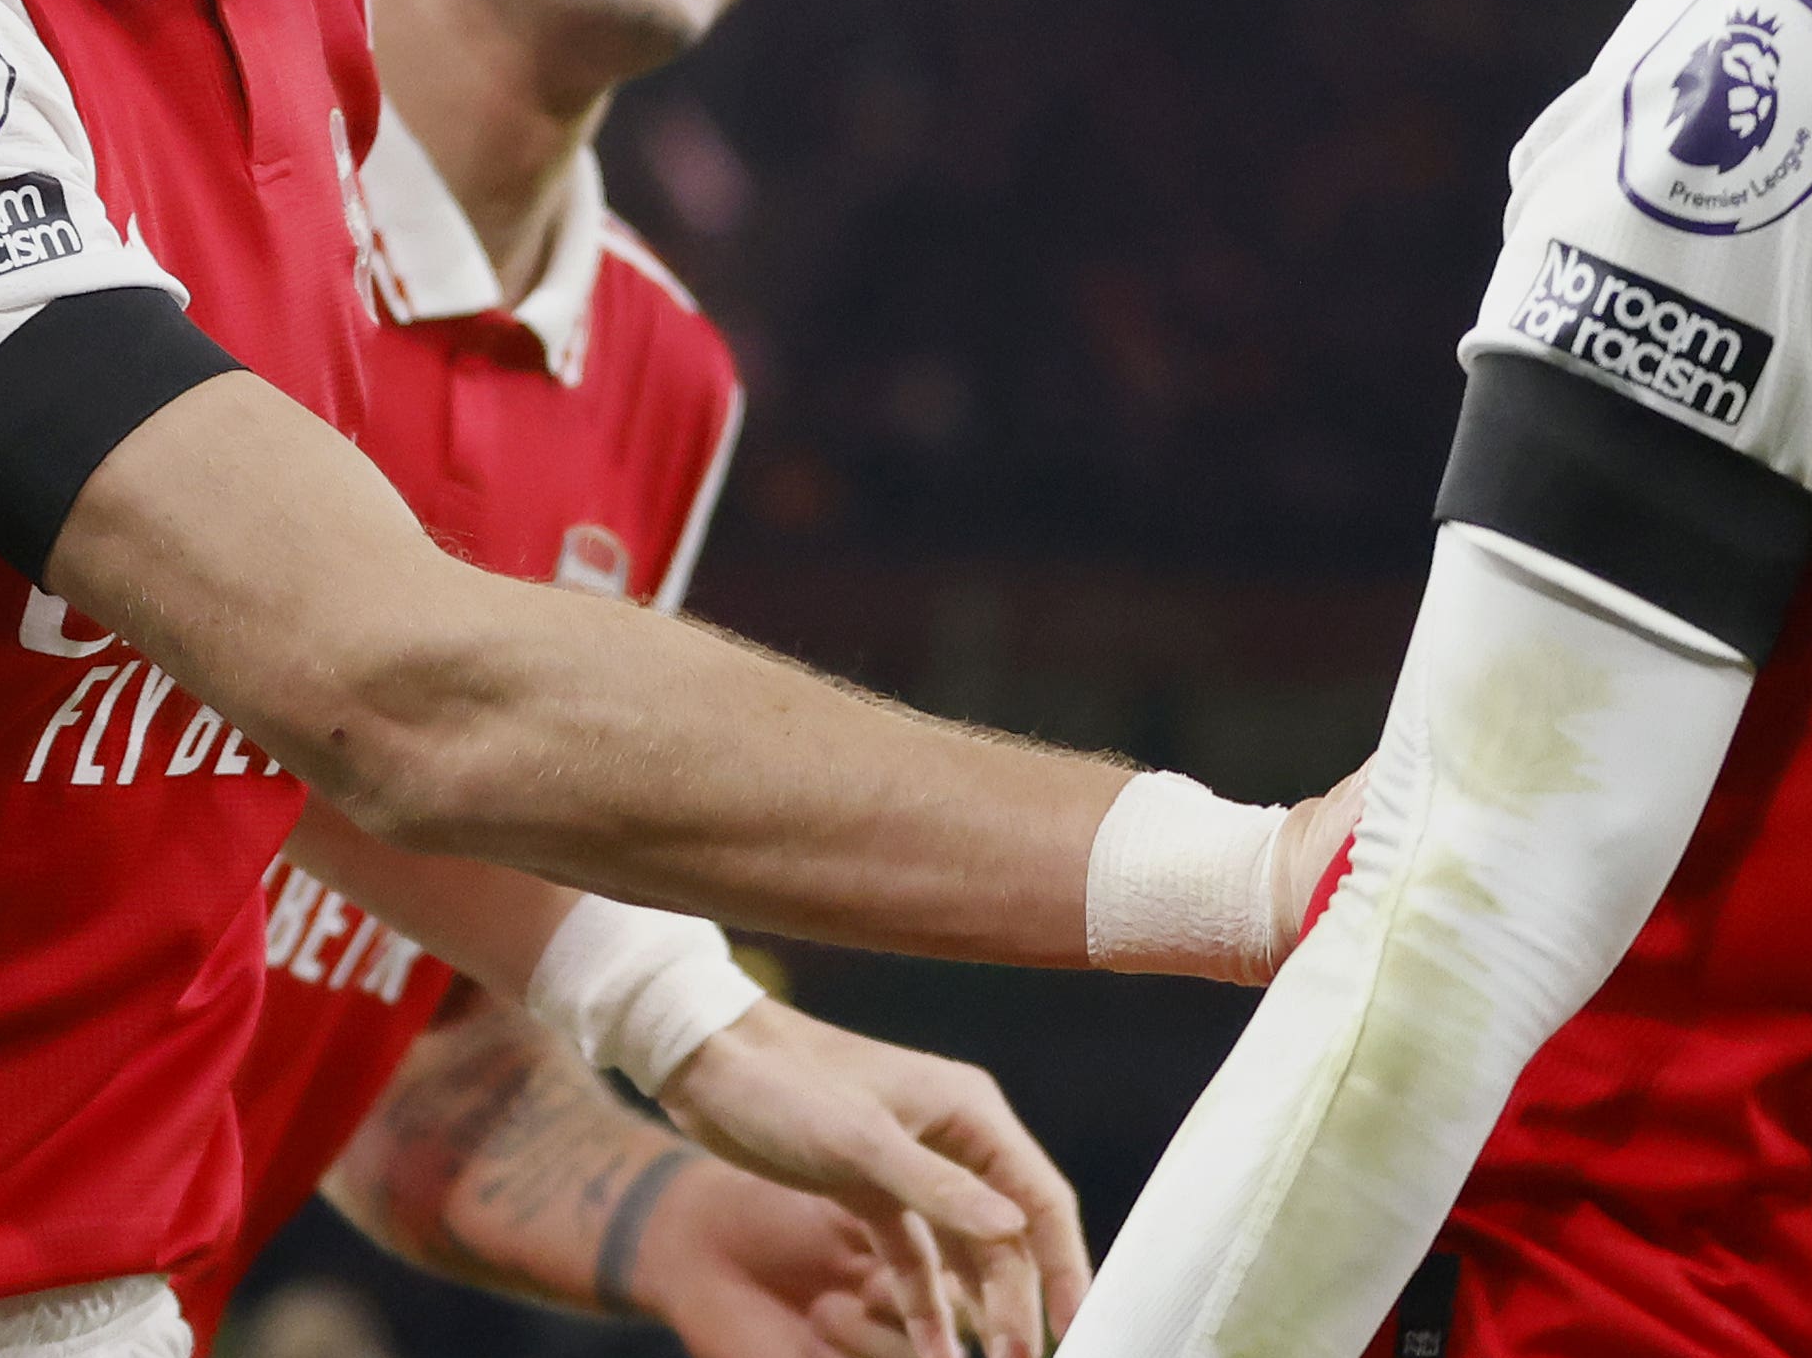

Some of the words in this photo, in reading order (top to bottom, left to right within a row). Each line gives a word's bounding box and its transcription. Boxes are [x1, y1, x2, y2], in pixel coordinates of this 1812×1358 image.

[1668, 180, 1748, 209] Premier
[1749, 127, 1811, 197] League
[1511, 291, 1578, 345] for
[1570, 316, 1747, 424] racism
[1535, 242, 1596, 304] No
[1592, 274, 1742, 373] room
[23, 660, 177, 785] FLY
